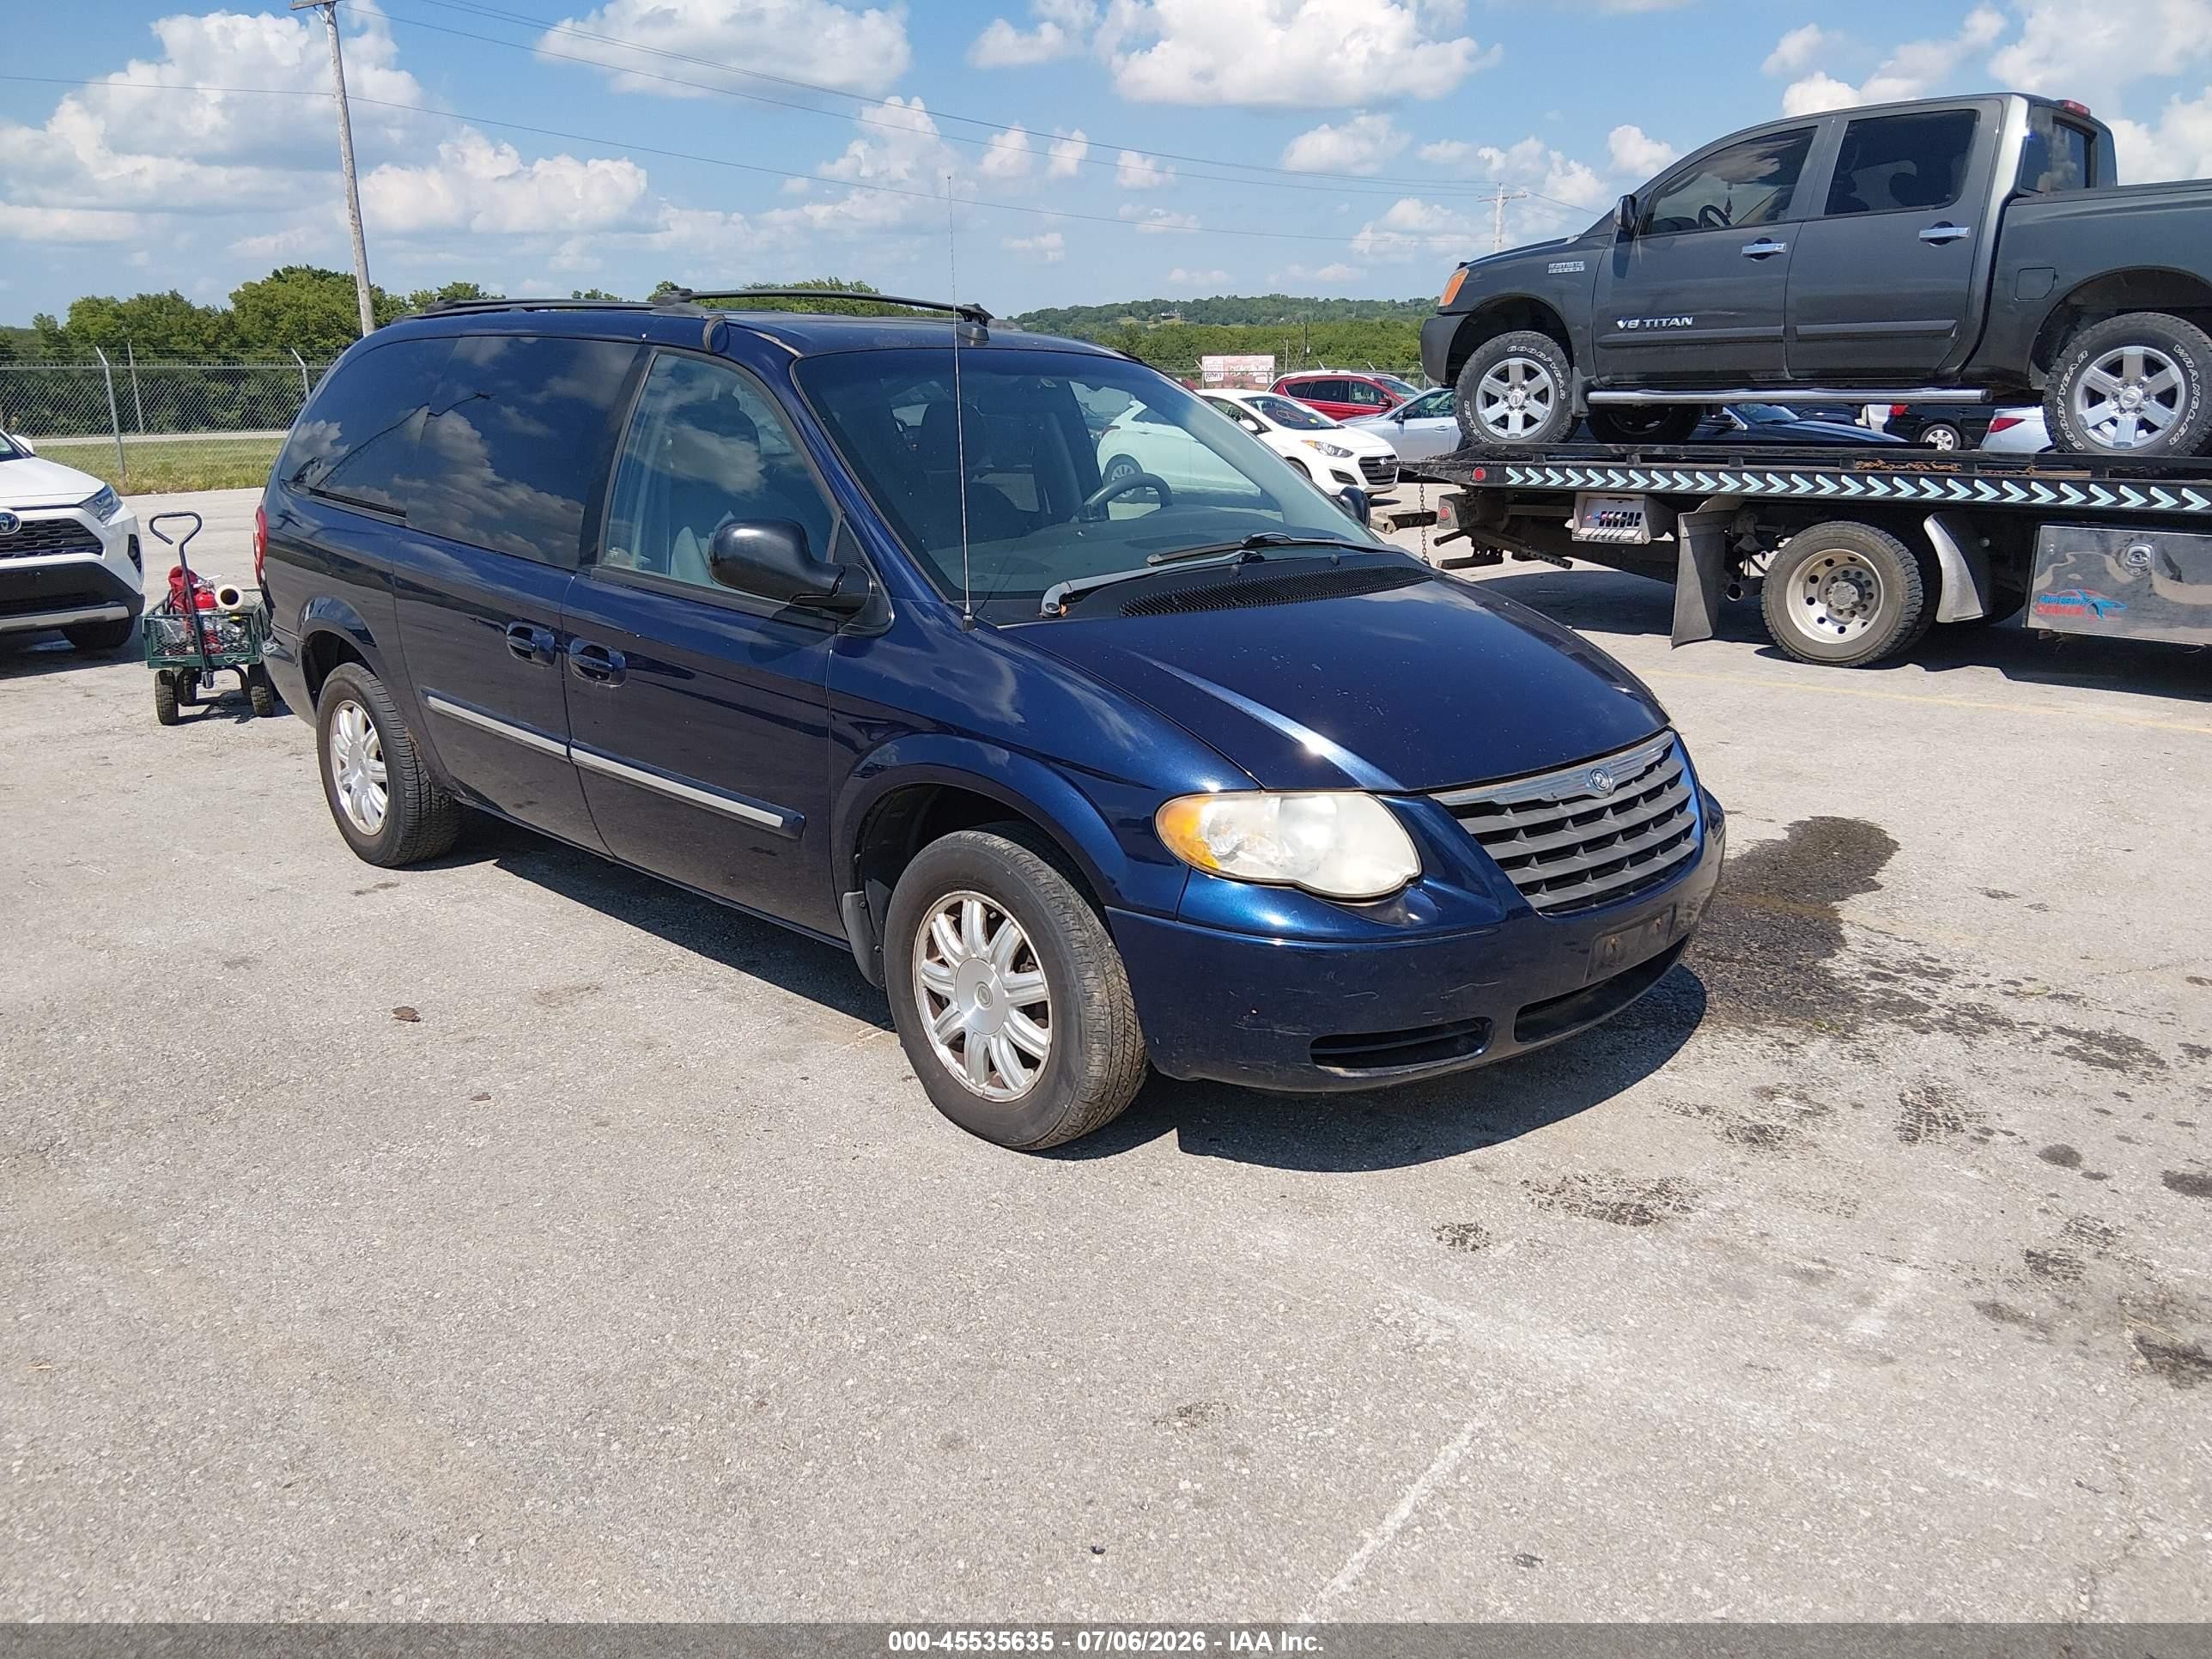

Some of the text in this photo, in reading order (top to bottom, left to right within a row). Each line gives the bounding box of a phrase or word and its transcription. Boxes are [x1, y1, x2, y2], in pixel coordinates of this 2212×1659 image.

[1616, 317, 1693, 330] V8 TITAN
[2057, 349, 2088, 450] GOODYEAR
[2169, 343, 2201, 446] WRANGLER
